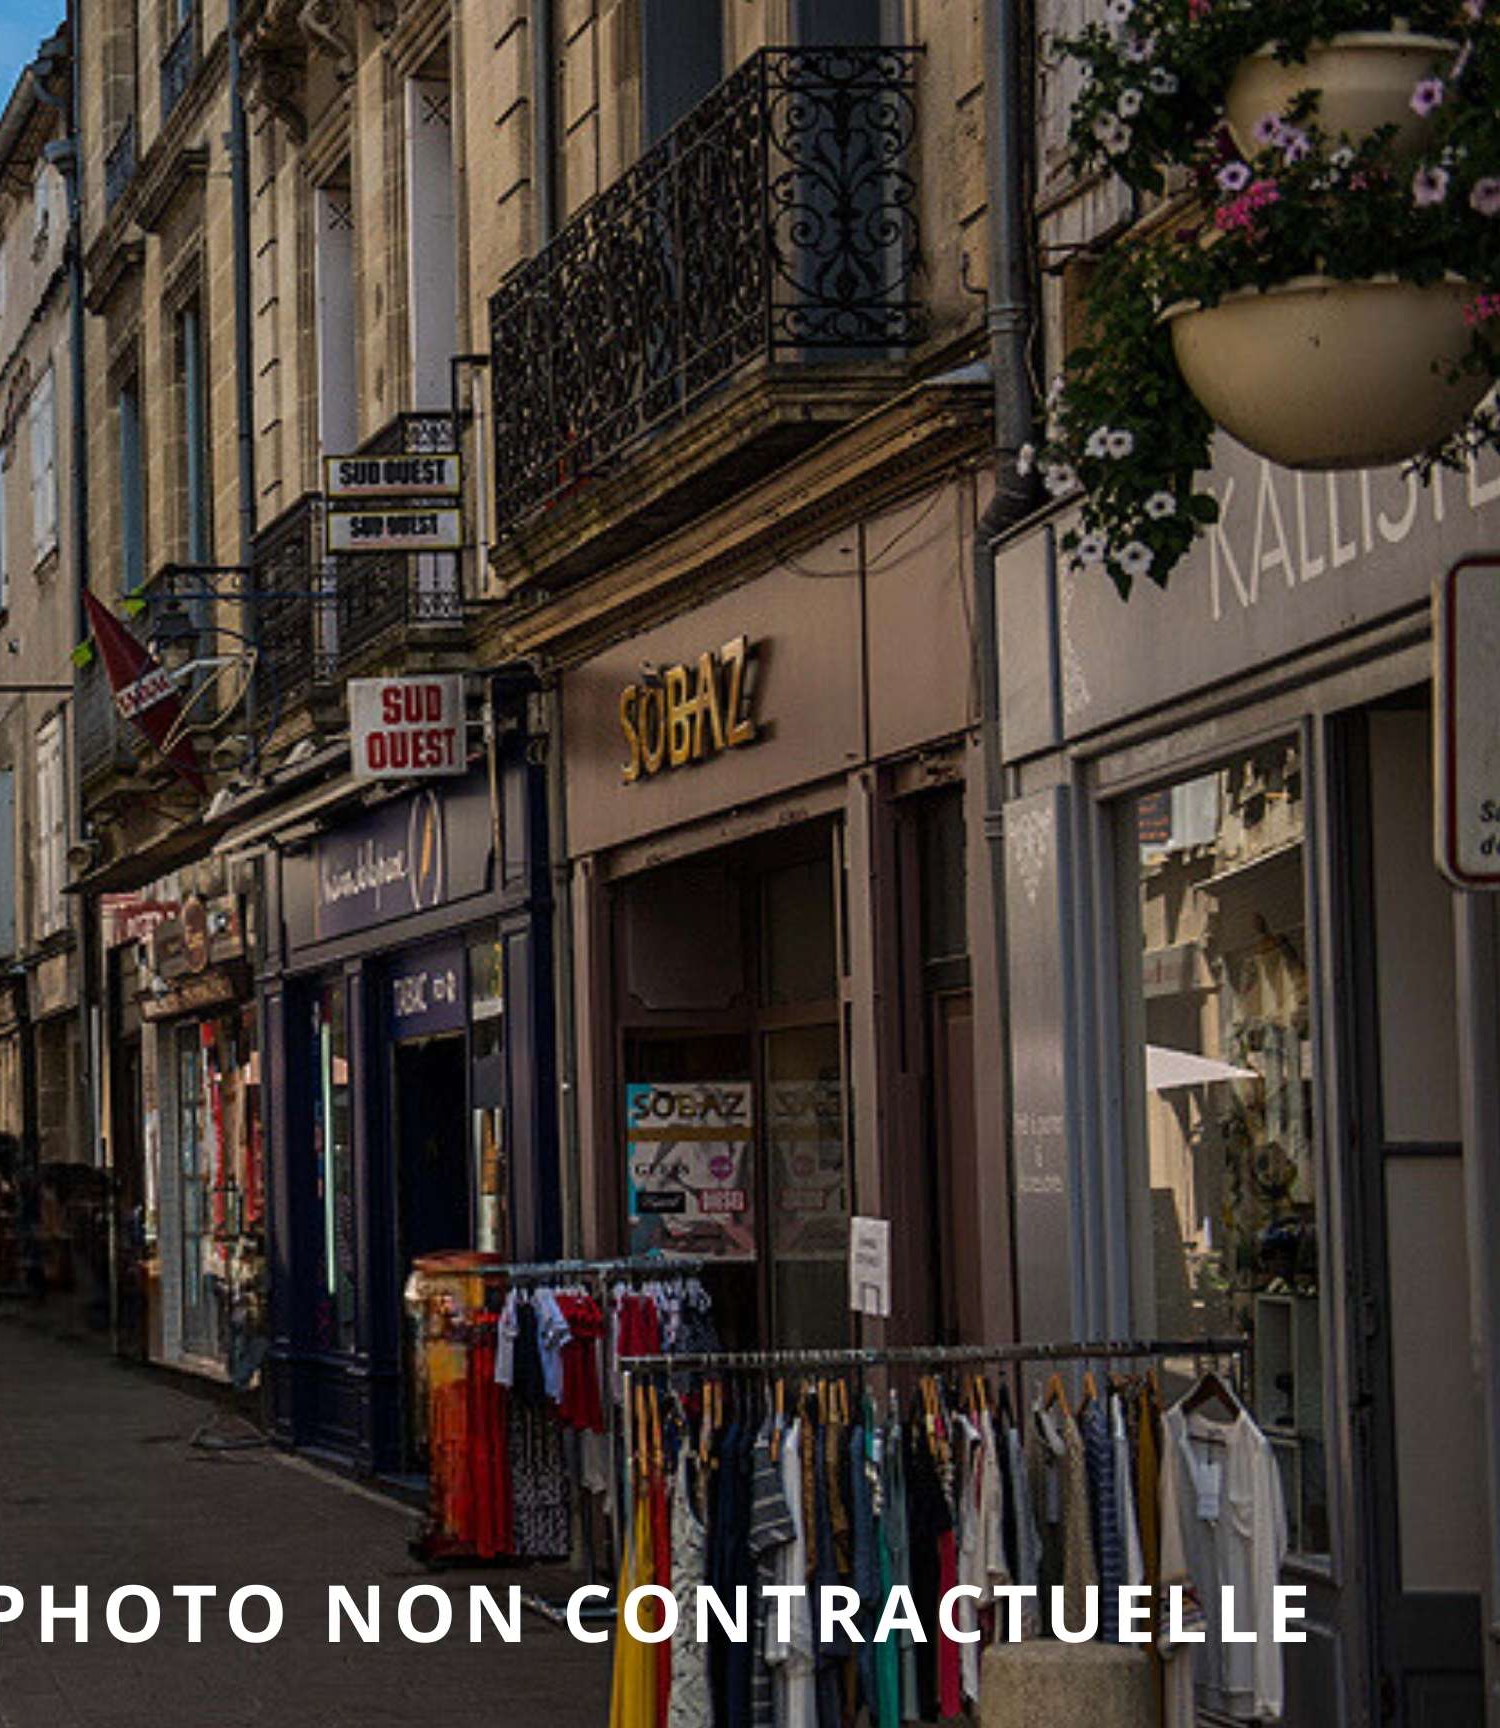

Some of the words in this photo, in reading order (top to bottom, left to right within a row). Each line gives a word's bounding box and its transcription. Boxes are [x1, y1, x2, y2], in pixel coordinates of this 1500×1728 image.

[339, 460, 380, 486] SUD
[383, 458, 446, 485] OUEST
[350, 515, 384, 538] SUD
[386, 512, 438, 536] OUEST
[382, 683, 443, 726] SUD
[366, 727, 457, 770] OUEST
